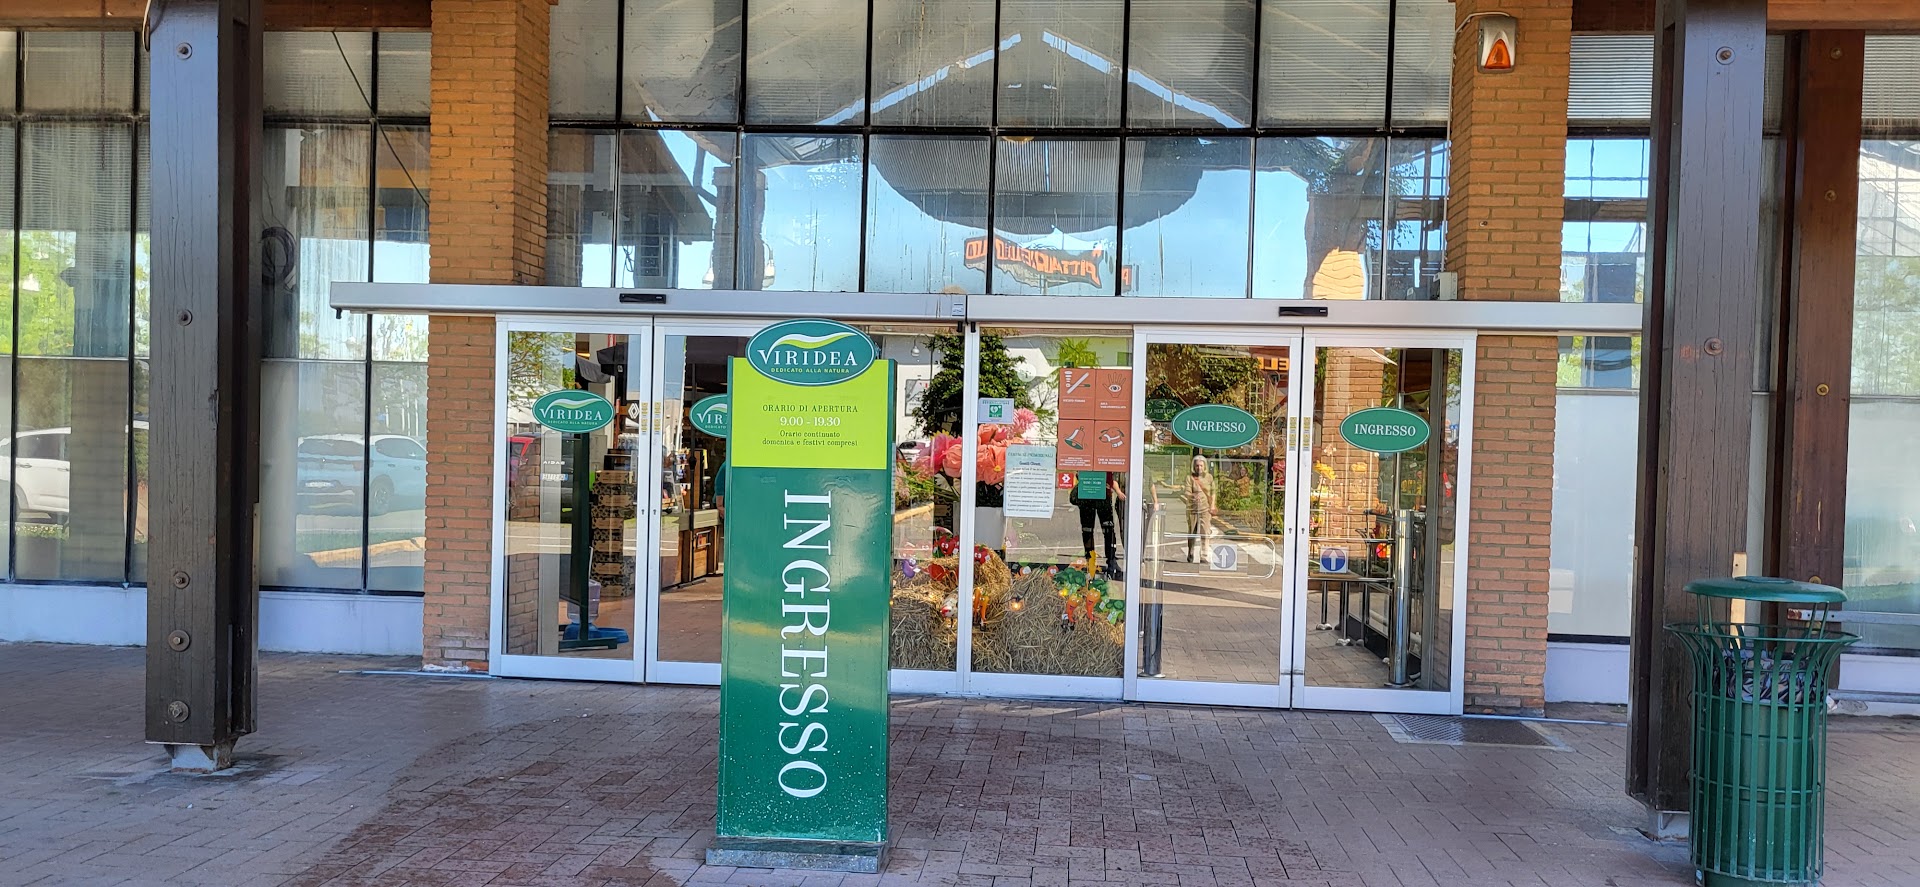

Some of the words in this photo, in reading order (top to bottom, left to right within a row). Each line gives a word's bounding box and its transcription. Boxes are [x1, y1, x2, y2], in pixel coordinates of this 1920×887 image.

[757, 345, 857, 366] VIRIDEA
[539, 406, 602, 421] VIRIDEA
[763, 404, 796, 412] ORARIO
[799, 404, 808, 412] DI
[812, 405, 859, 413] APERTURA
[697, 410, 727, 424] VIR
[780, 416, 804, 426] 9.00
[814, 416, 841, 427] 19.30
[1186, 420, 1246, 433] INGRESSO
[1354, 423, 1416, 437] INGRESSO
[762, 438, 794, 446] domenica
[827, 439, 858, 448] compresi
[778, 489, 831, 798] INGRESSO
